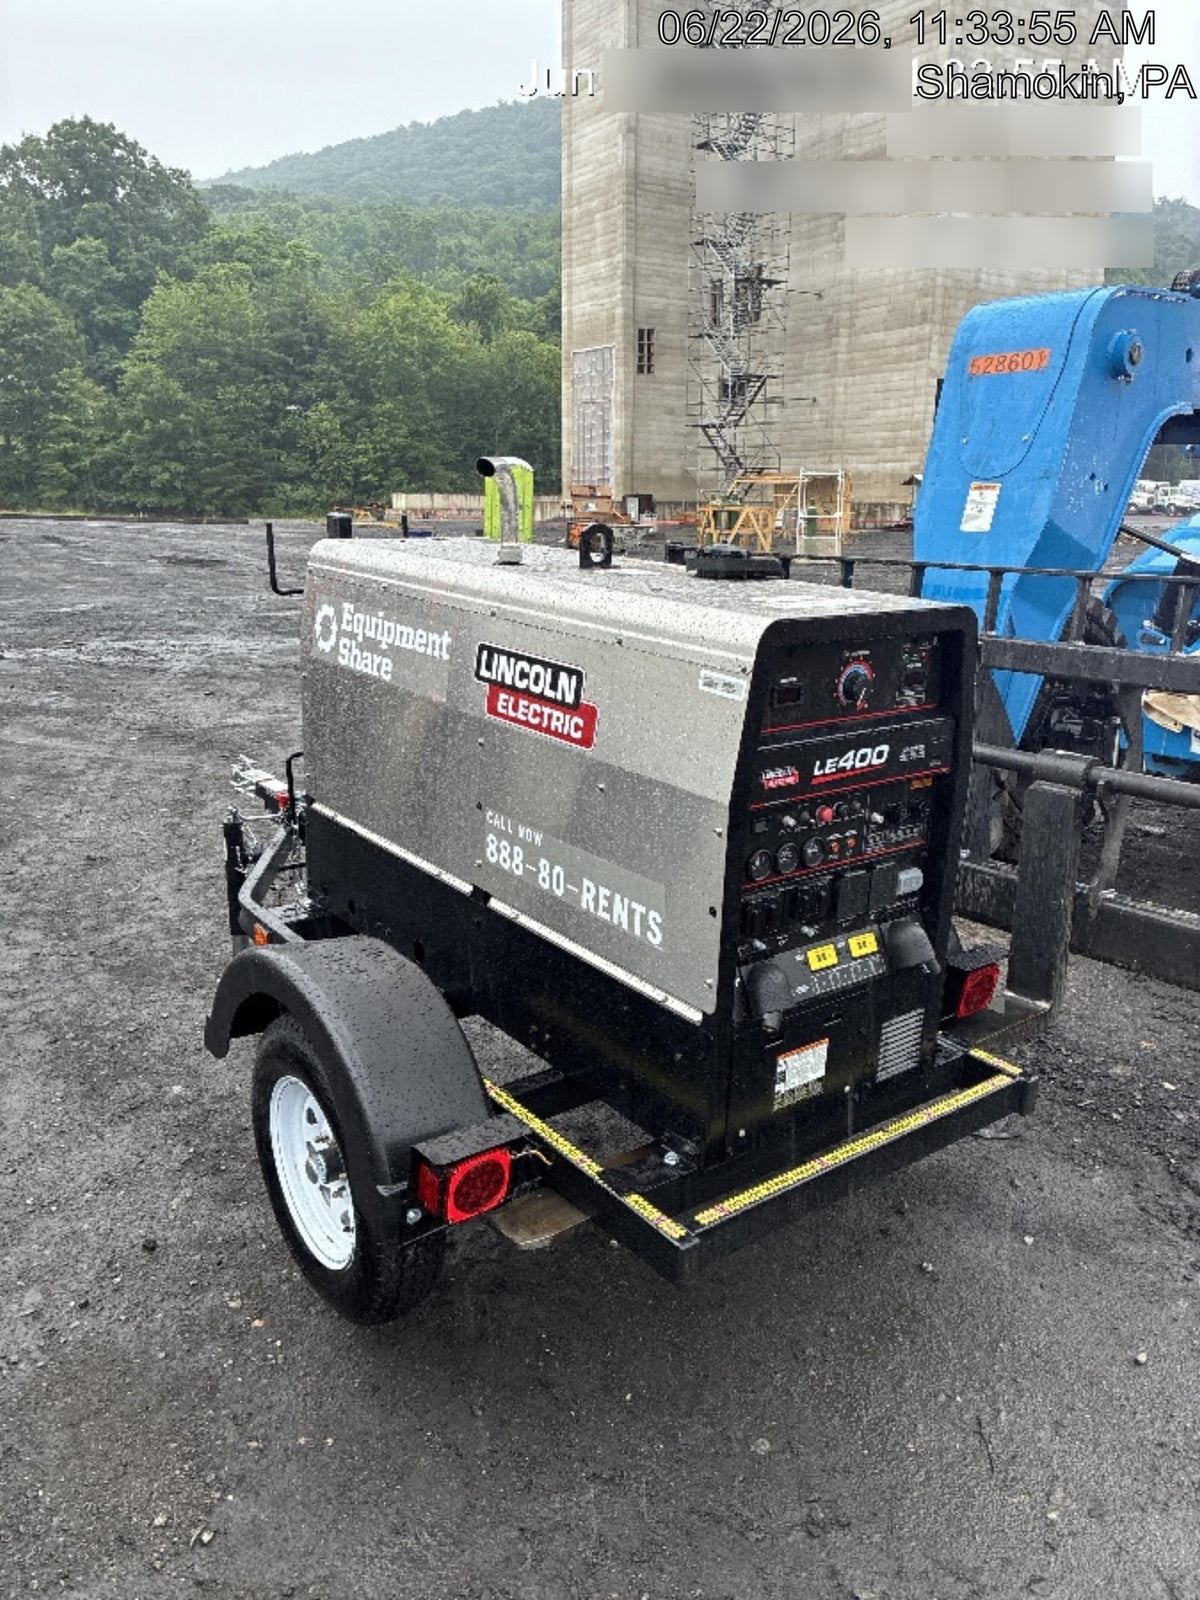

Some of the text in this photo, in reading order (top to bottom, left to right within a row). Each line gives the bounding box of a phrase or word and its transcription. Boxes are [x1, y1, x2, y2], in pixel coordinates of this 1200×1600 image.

[341, 602, 452, 660] Equipment
[337, 637, 393, 681] Share
[480, 650, 577, 705] LINCOLN
[497, 693, 584, 739] ELECTRIC
[813, 744, 890, 776] LE400
[487, 810, 543, 846] CALL NOW
[486, 833, 663, 945] 888-80-RENTS
